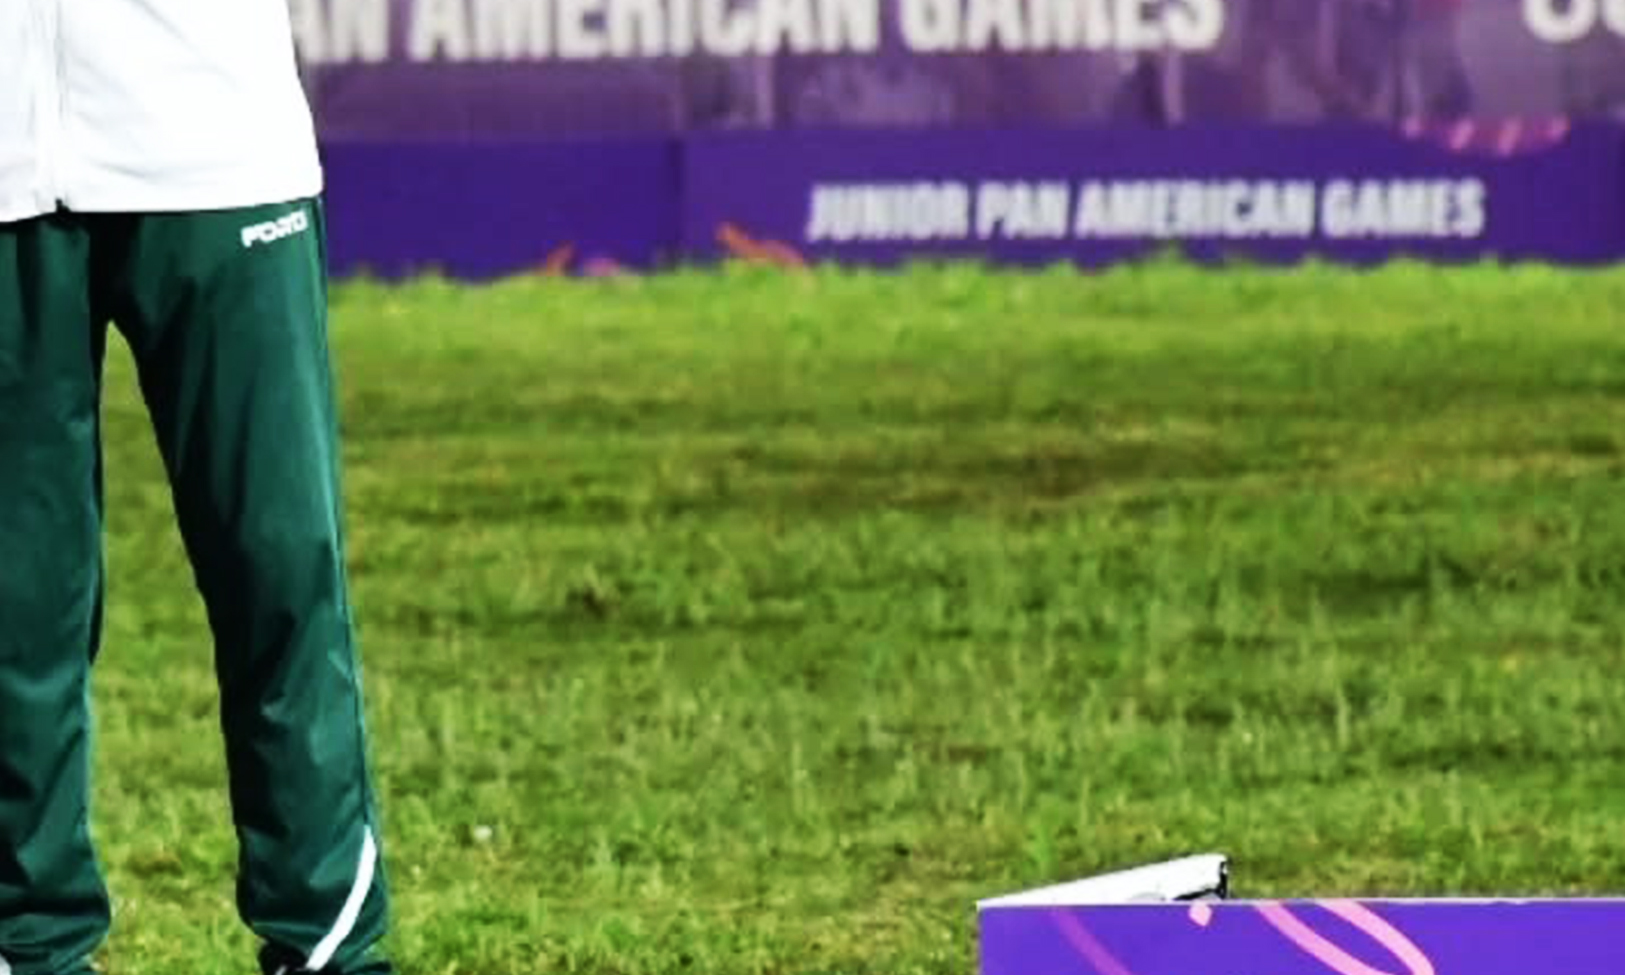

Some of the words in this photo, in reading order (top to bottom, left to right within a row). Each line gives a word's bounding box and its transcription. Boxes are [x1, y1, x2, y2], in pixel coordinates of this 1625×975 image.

[808, 182, 970, 241] JUNIOR
[976, 181, 1069, 238] PAN
[1074, 180, 1315, 239] AMERICAN
[1321, 179, 1485, 238] GAMES
